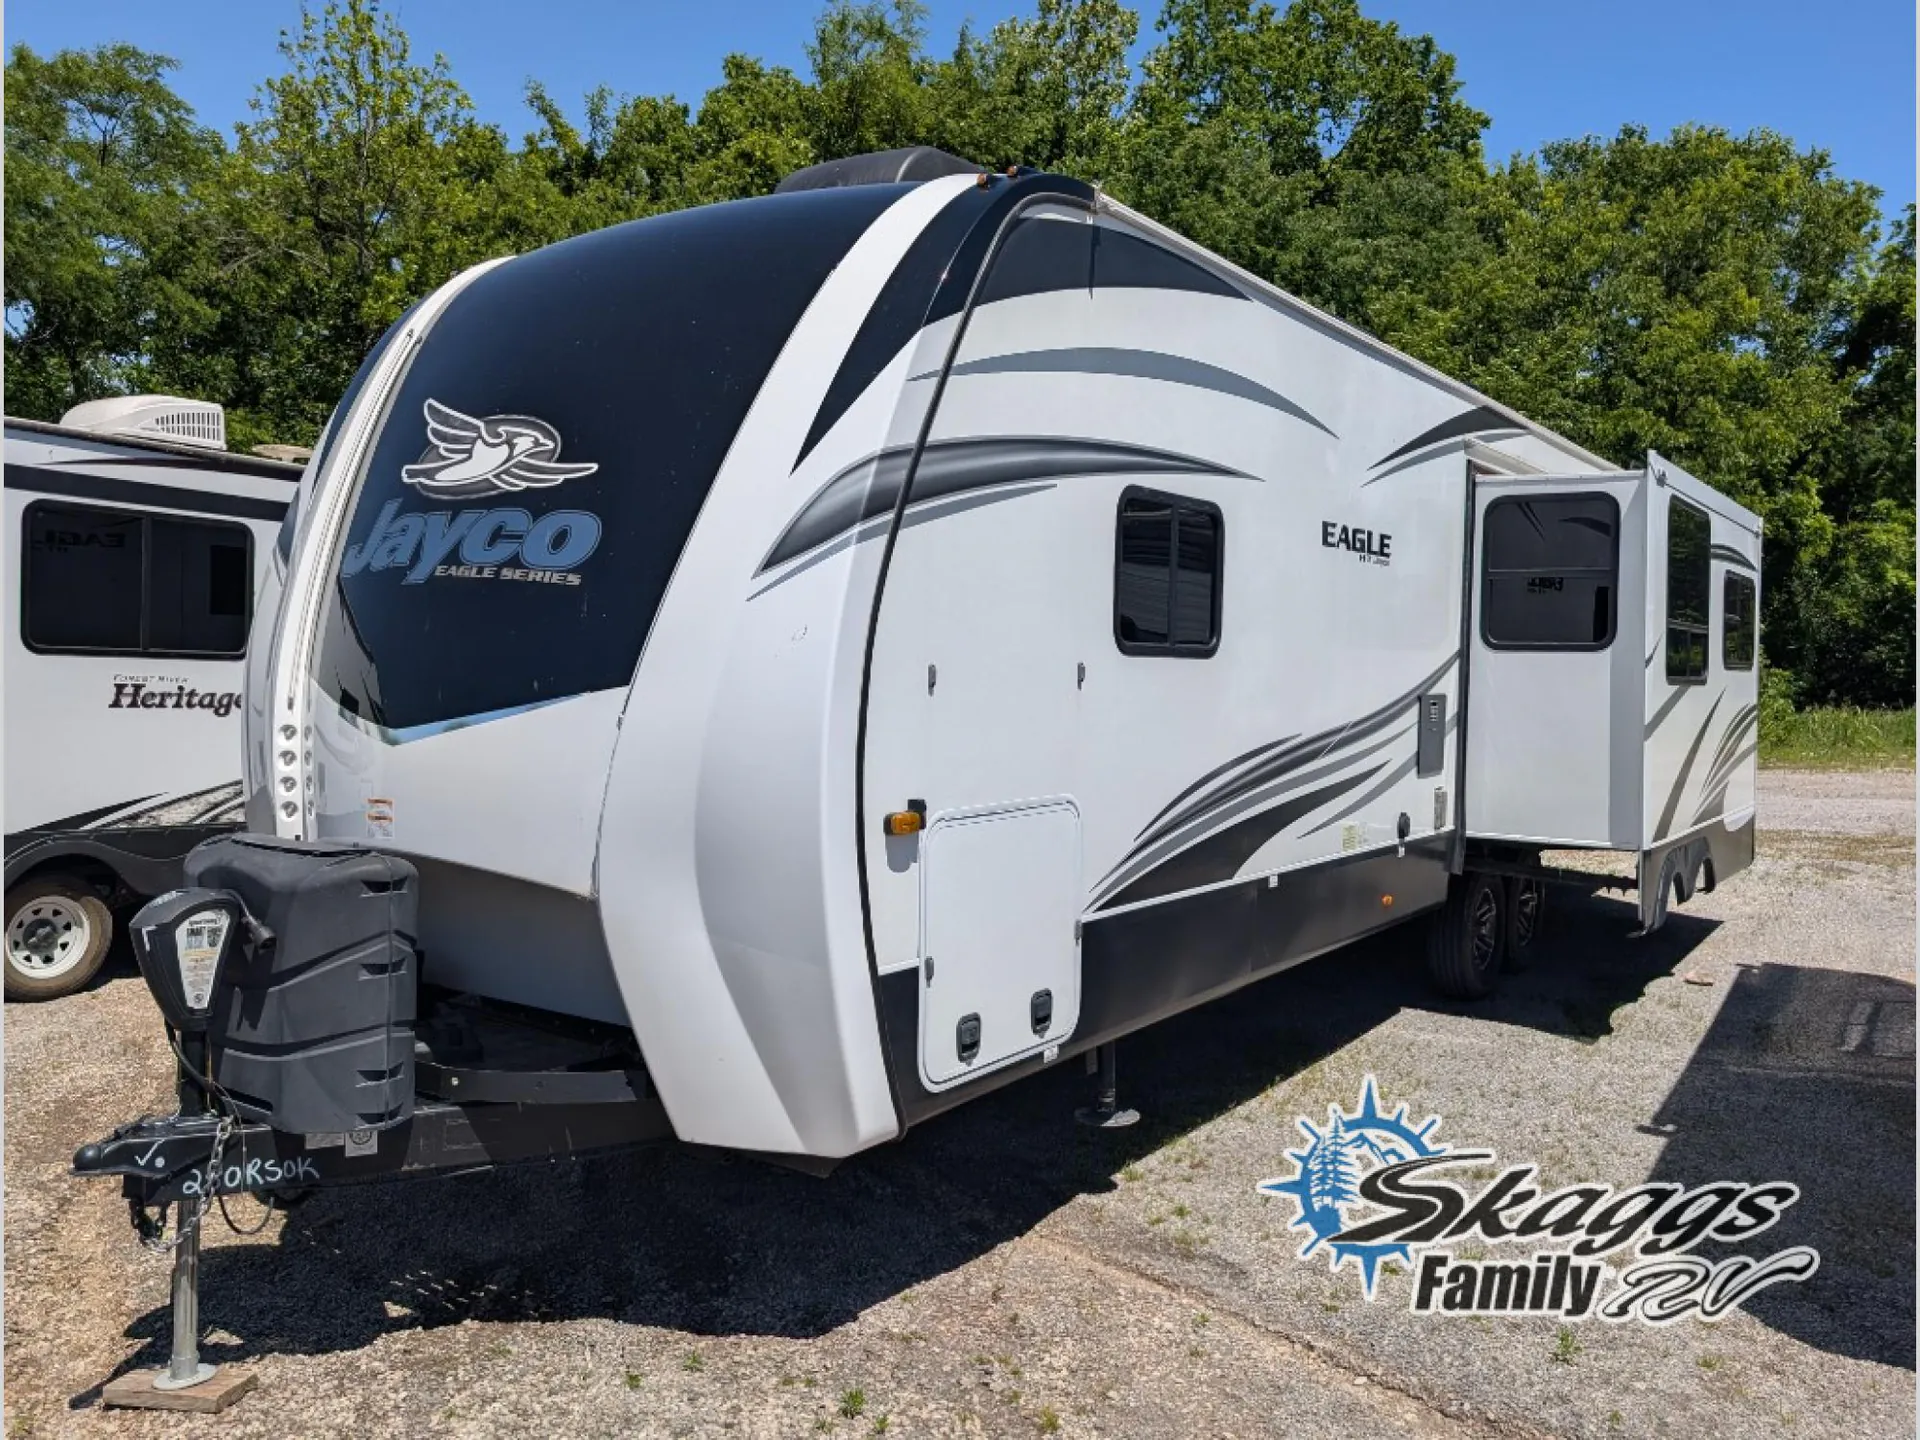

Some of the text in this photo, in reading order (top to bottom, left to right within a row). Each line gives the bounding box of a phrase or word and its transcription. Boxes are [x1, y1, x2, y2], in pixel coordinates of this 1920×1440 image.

[341, 498, 602, 586] Jayco
[1321, 520, 1392, 559] EAGLE
[434, 565, 582, 586] EAGLE SERIES
